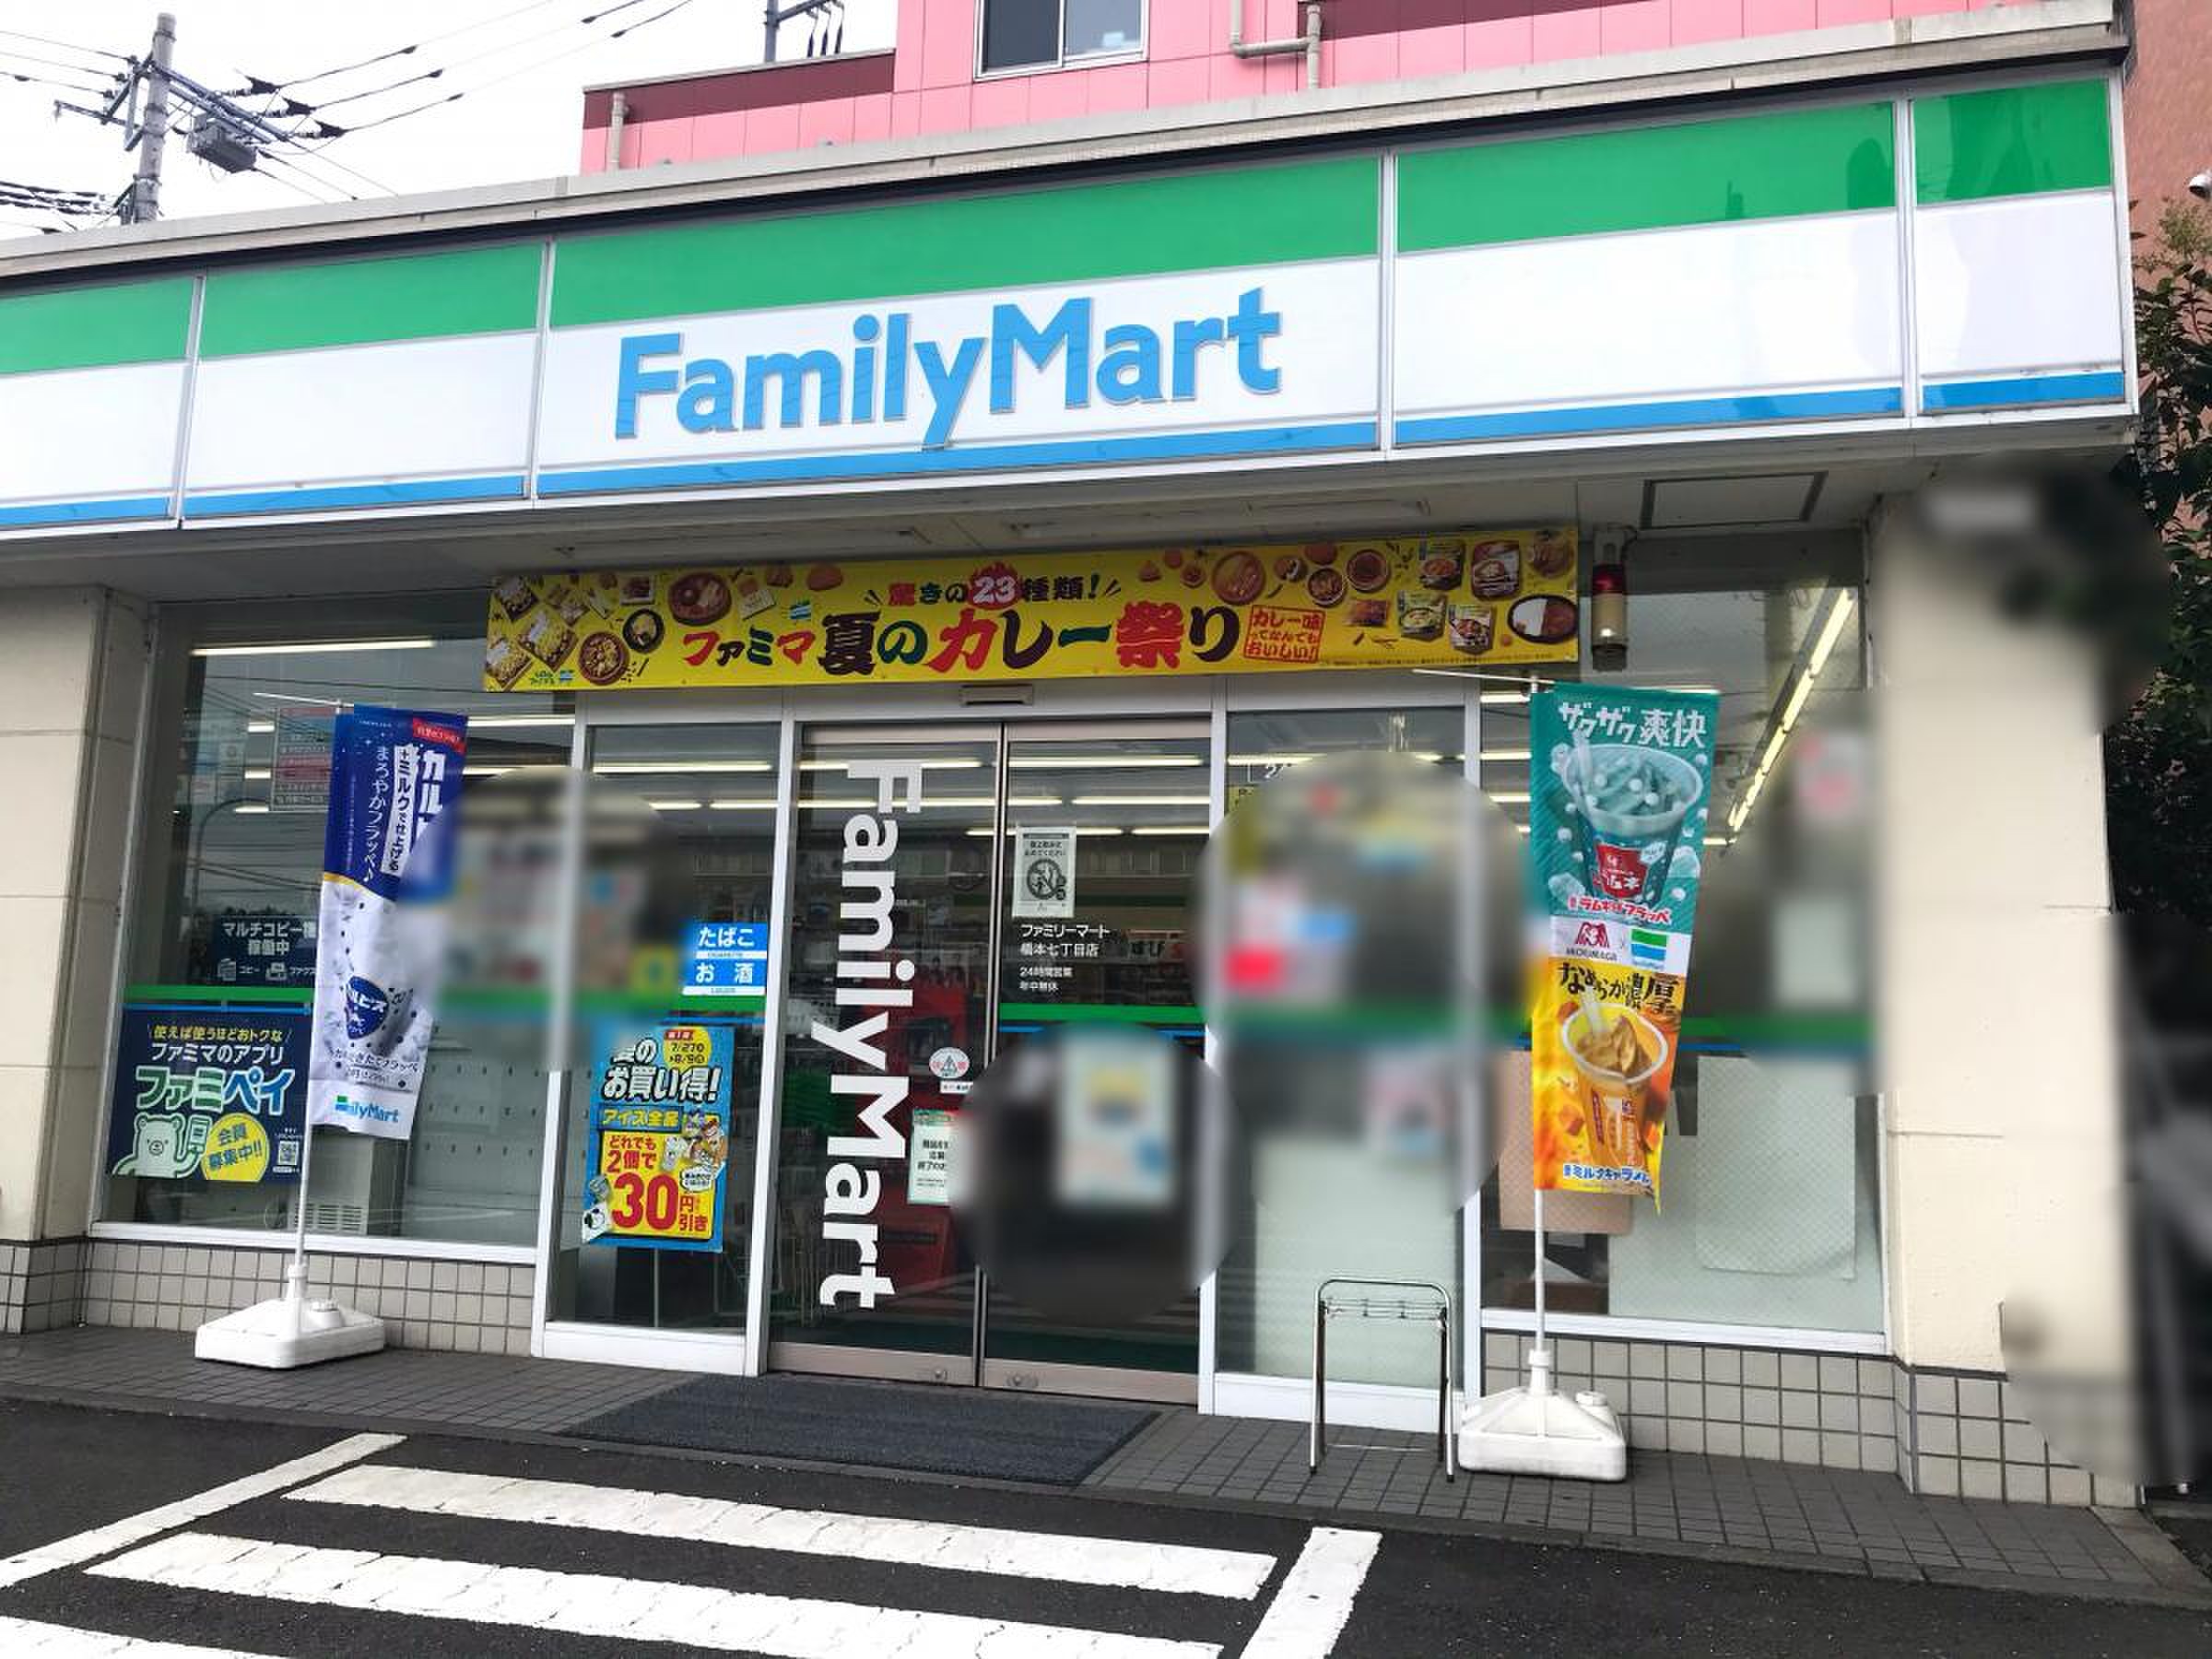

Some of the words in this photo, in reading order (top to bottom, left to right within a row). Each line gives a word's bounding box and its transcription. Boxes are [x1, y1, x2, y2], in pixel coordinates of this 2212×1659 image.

[614, 288, 1282, 451] FamilyMart
[683, 601, 1239, 676] ファミマ夏のカレー祭り
[1559, 701, 1707, 748] ザクザク爽快
[221, 921, 316, 938] マルチコピー機
[698, 926, 756, 948] たばこ
[1019, 923, 1111, 939] ファミリーマート
[696, 961, 756, 983] お酒
[154, 1024, 283, 1042] 使えば使うほどおトクな
[811, 760, 923, 1311] FamilyMart
[151, 1042, 284, 1065] ファミマのアプリ
[135, 1065, 295, 1115] ファミペイ
[604, 1066, 722, 1102] お買い得!
[603, 1109, 680, 1128] アイス全品
[609, 1135, 657, 1151] どれでも
[607, 1149, 657, 1173] 2個で
[612, 1171, 679, 1230] 30
[679, 1195, 695, 1213] 円
[678, 1213, 709, 1232] 引き
